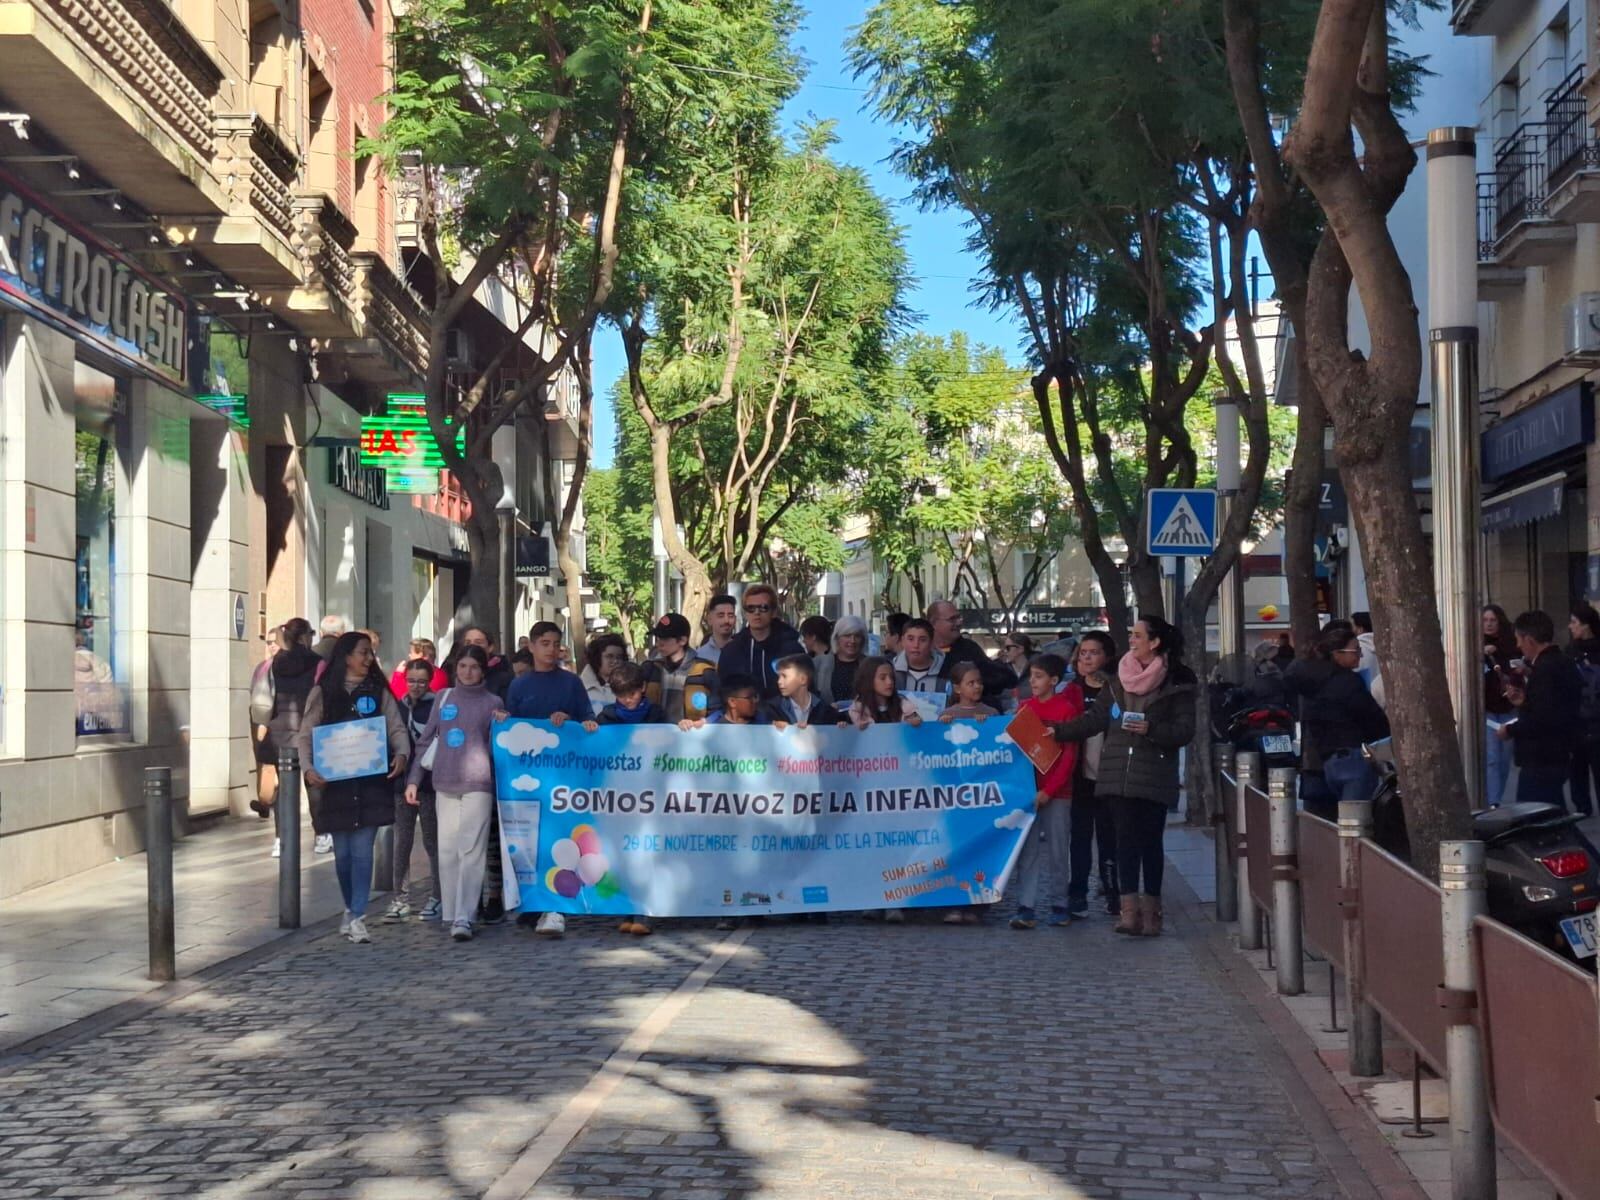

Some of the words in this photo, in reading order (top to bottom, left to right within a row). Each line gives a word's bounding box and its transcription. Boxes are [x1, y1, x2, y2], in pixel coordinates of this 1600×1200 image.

[519, 750, 642, 775] #SomosPropuestas
[653, 753, 767, 773] #SomosAltavoces
[777, 755, 899, 778] #SomosParticipación
[909, 746, 1013, 770] #SomosInfancia
[552, 786, 655, 814] SOMOS
[663, 791, 785, 815] ALTAVOZ
[793, 792, 823, 815] DE
[830, 791, 857, 813] LA
[866, 782, 1003, 812] INFANCIA
[623, 834, 640, 851] 20
[644, 834, 661, 851] DE
[664, 834, 738, 851] NOVIEMBRE
[780, 834, 831, 850] MUNDIAL
[835, 832, 850, 849] DE
[855, 832, 871, 849] LA
[875, 829, 940, 848] INFANCIA
[933, 857, 948, 871] AL
